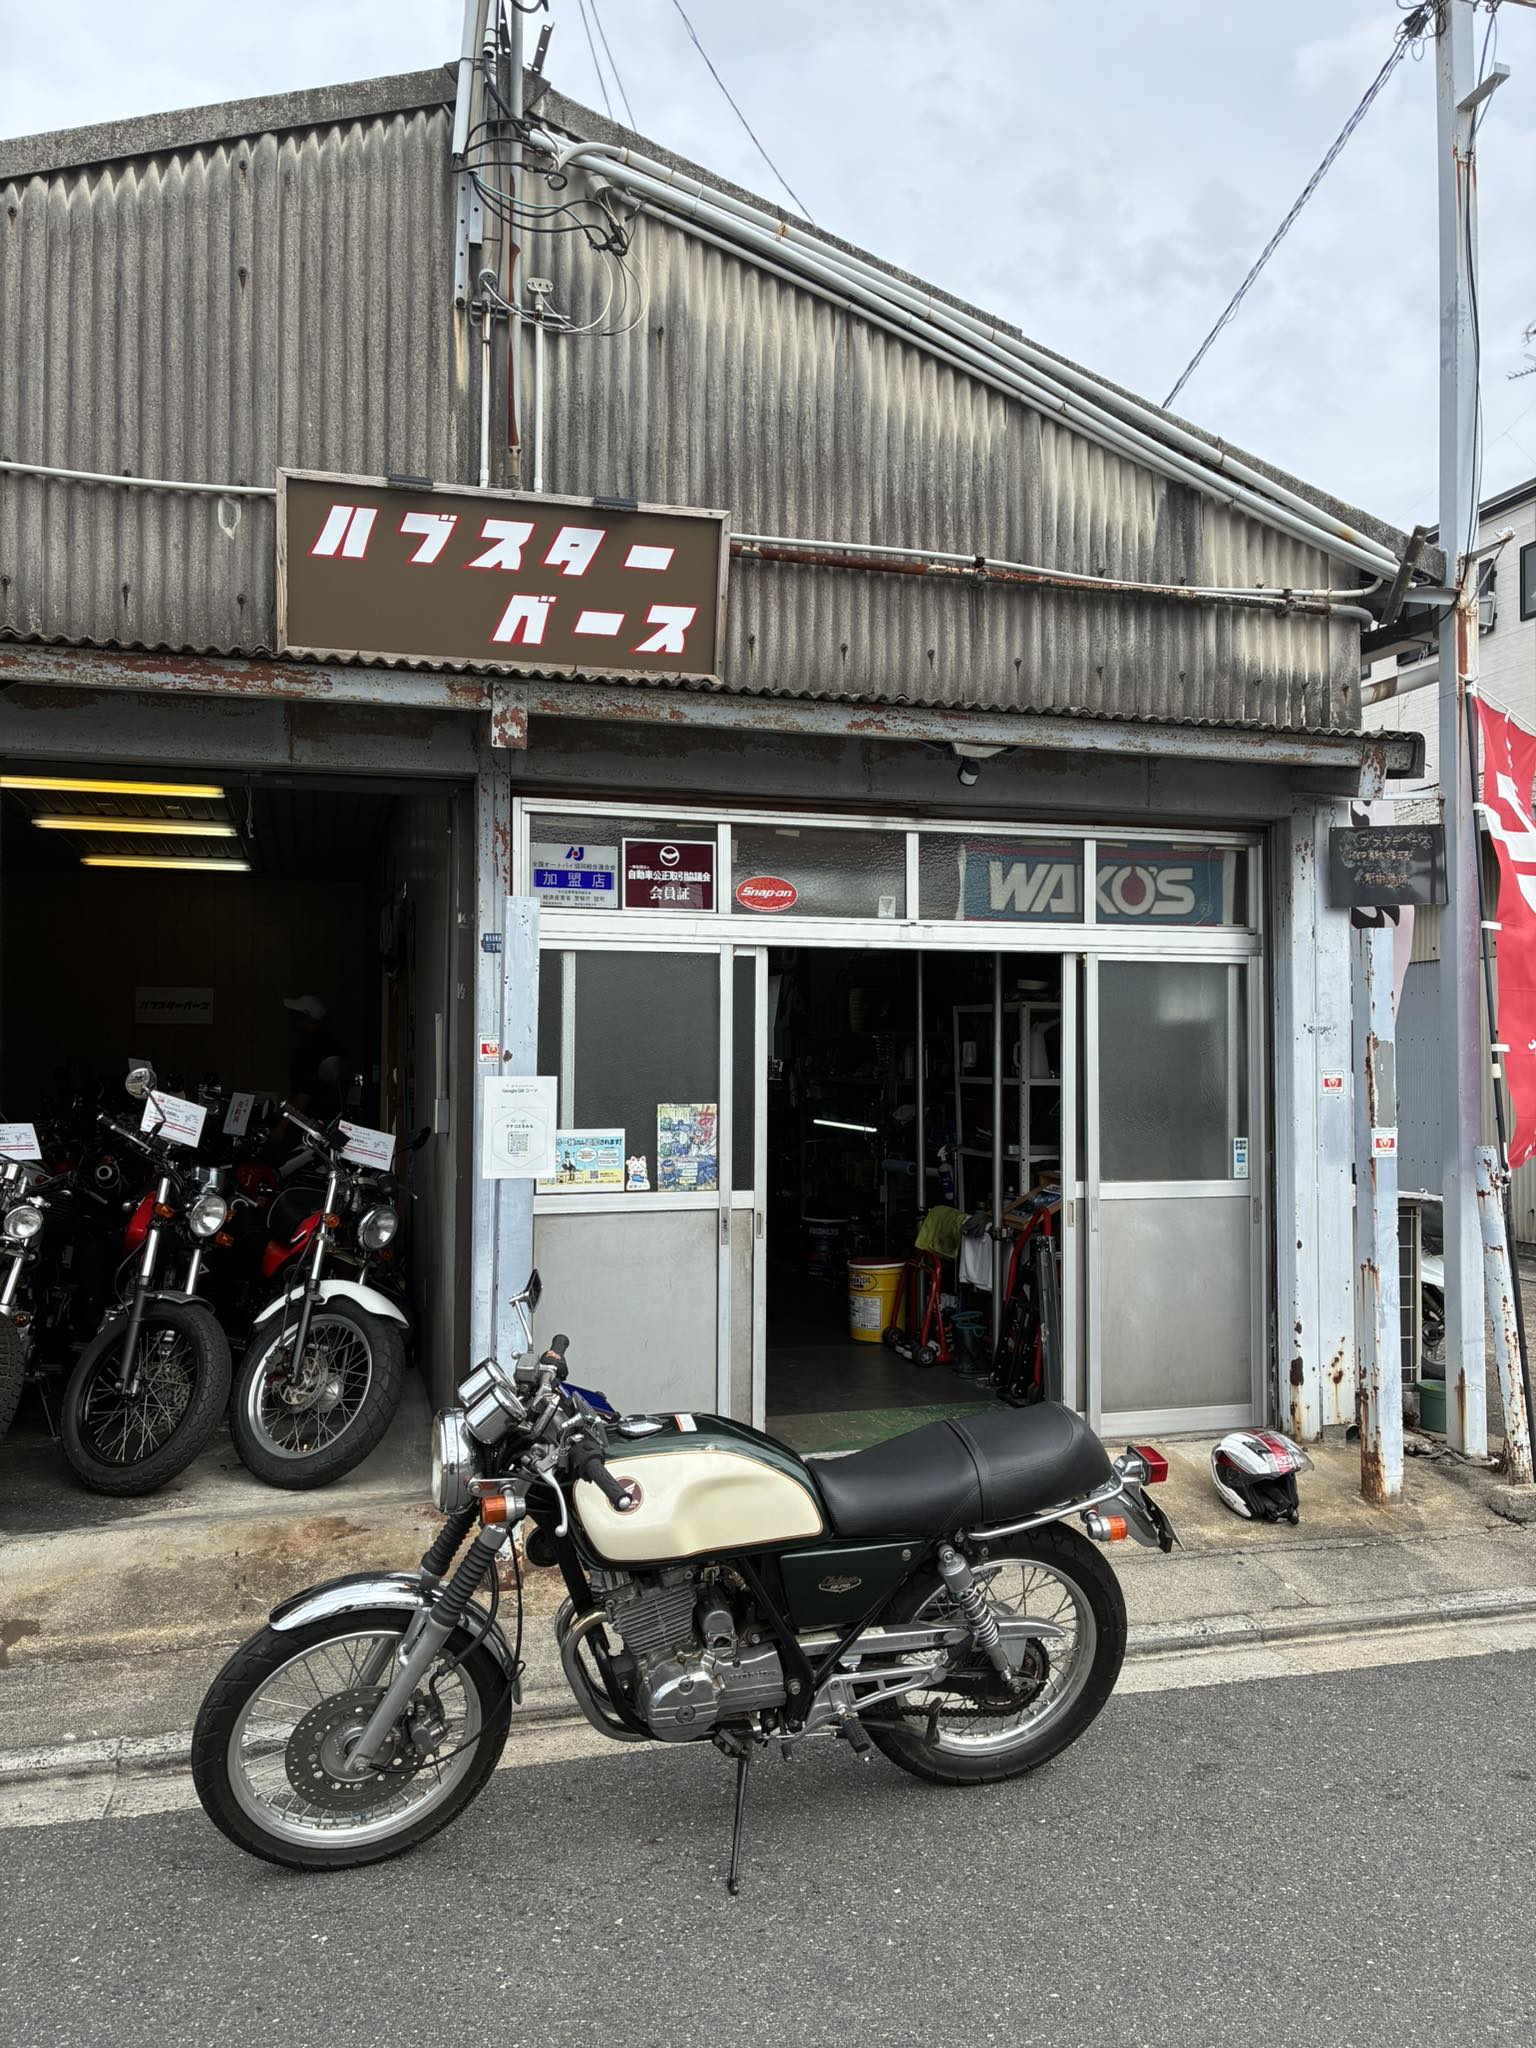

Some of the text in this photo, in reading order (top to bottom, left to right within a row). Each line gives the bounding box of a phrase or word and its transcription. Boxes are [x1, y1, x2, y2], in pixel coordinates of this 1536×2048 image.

[309, 504, 676, 577] ハブスター
[542, 871, 606, 888] 加盟店
[628, 869, 711, 883] 自動車公正取引協議会
[650, 886, 690, 901] 会員証
[989, 860, 1195, 916] WAKO'S
